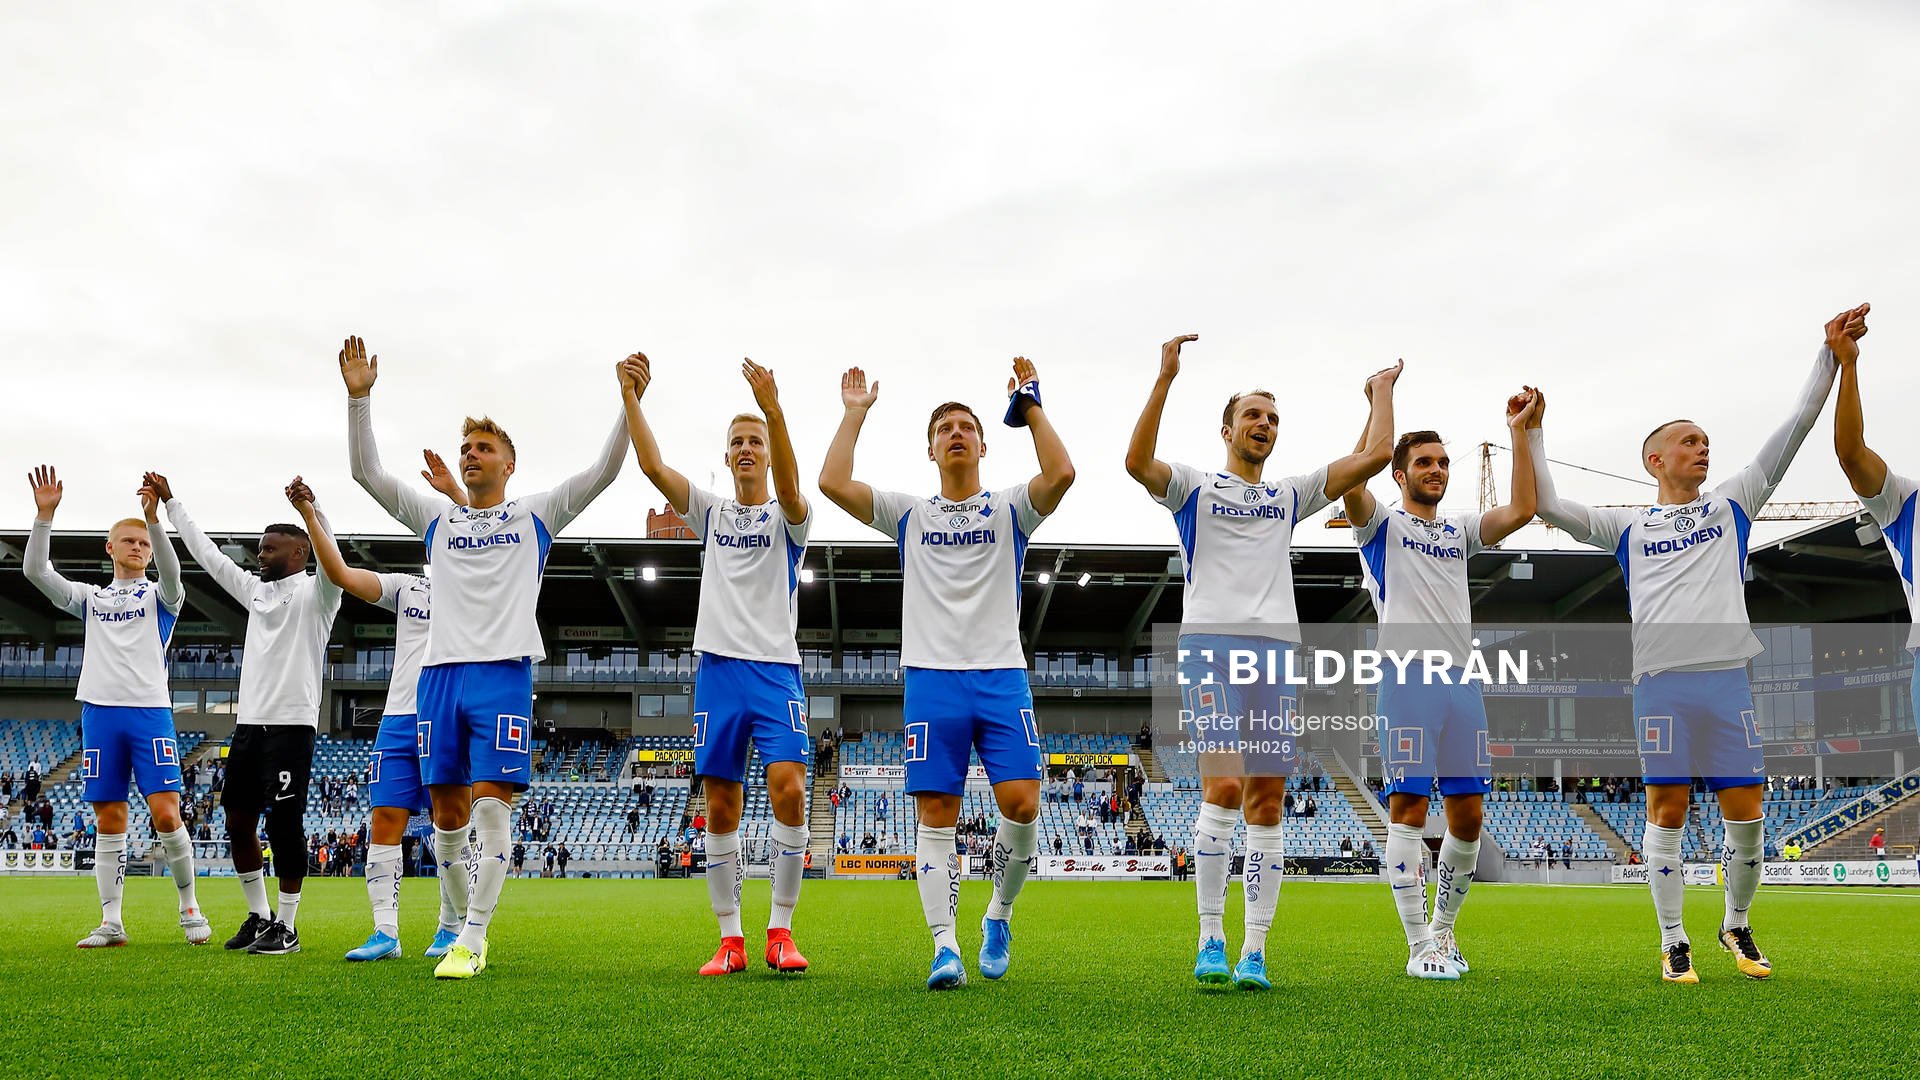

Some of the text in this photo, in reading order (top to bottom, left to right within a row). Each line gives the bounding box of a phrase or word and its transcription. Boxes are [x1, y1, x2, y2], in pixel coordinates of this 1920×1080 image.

[1212, 503, 1285, 520] HOLMEN
[448, 532, 521, 550] HOLMEN
[921, 530, 996, 546] HOLMEN
[1643, 525, 1723, 557] HOLMEN
[1402, 537, 1464, 560] HOLMEN
[564, 629, 599, 638] Canon
[1065, 755, 1112, 764] PACKOPLOCK
[278, 770, 292, 791] 9
[840, 860, 862, 869] LBC
[1764, 865, 1793, 876] Scandic
[1800, 864, 1830, 876] Scandic
